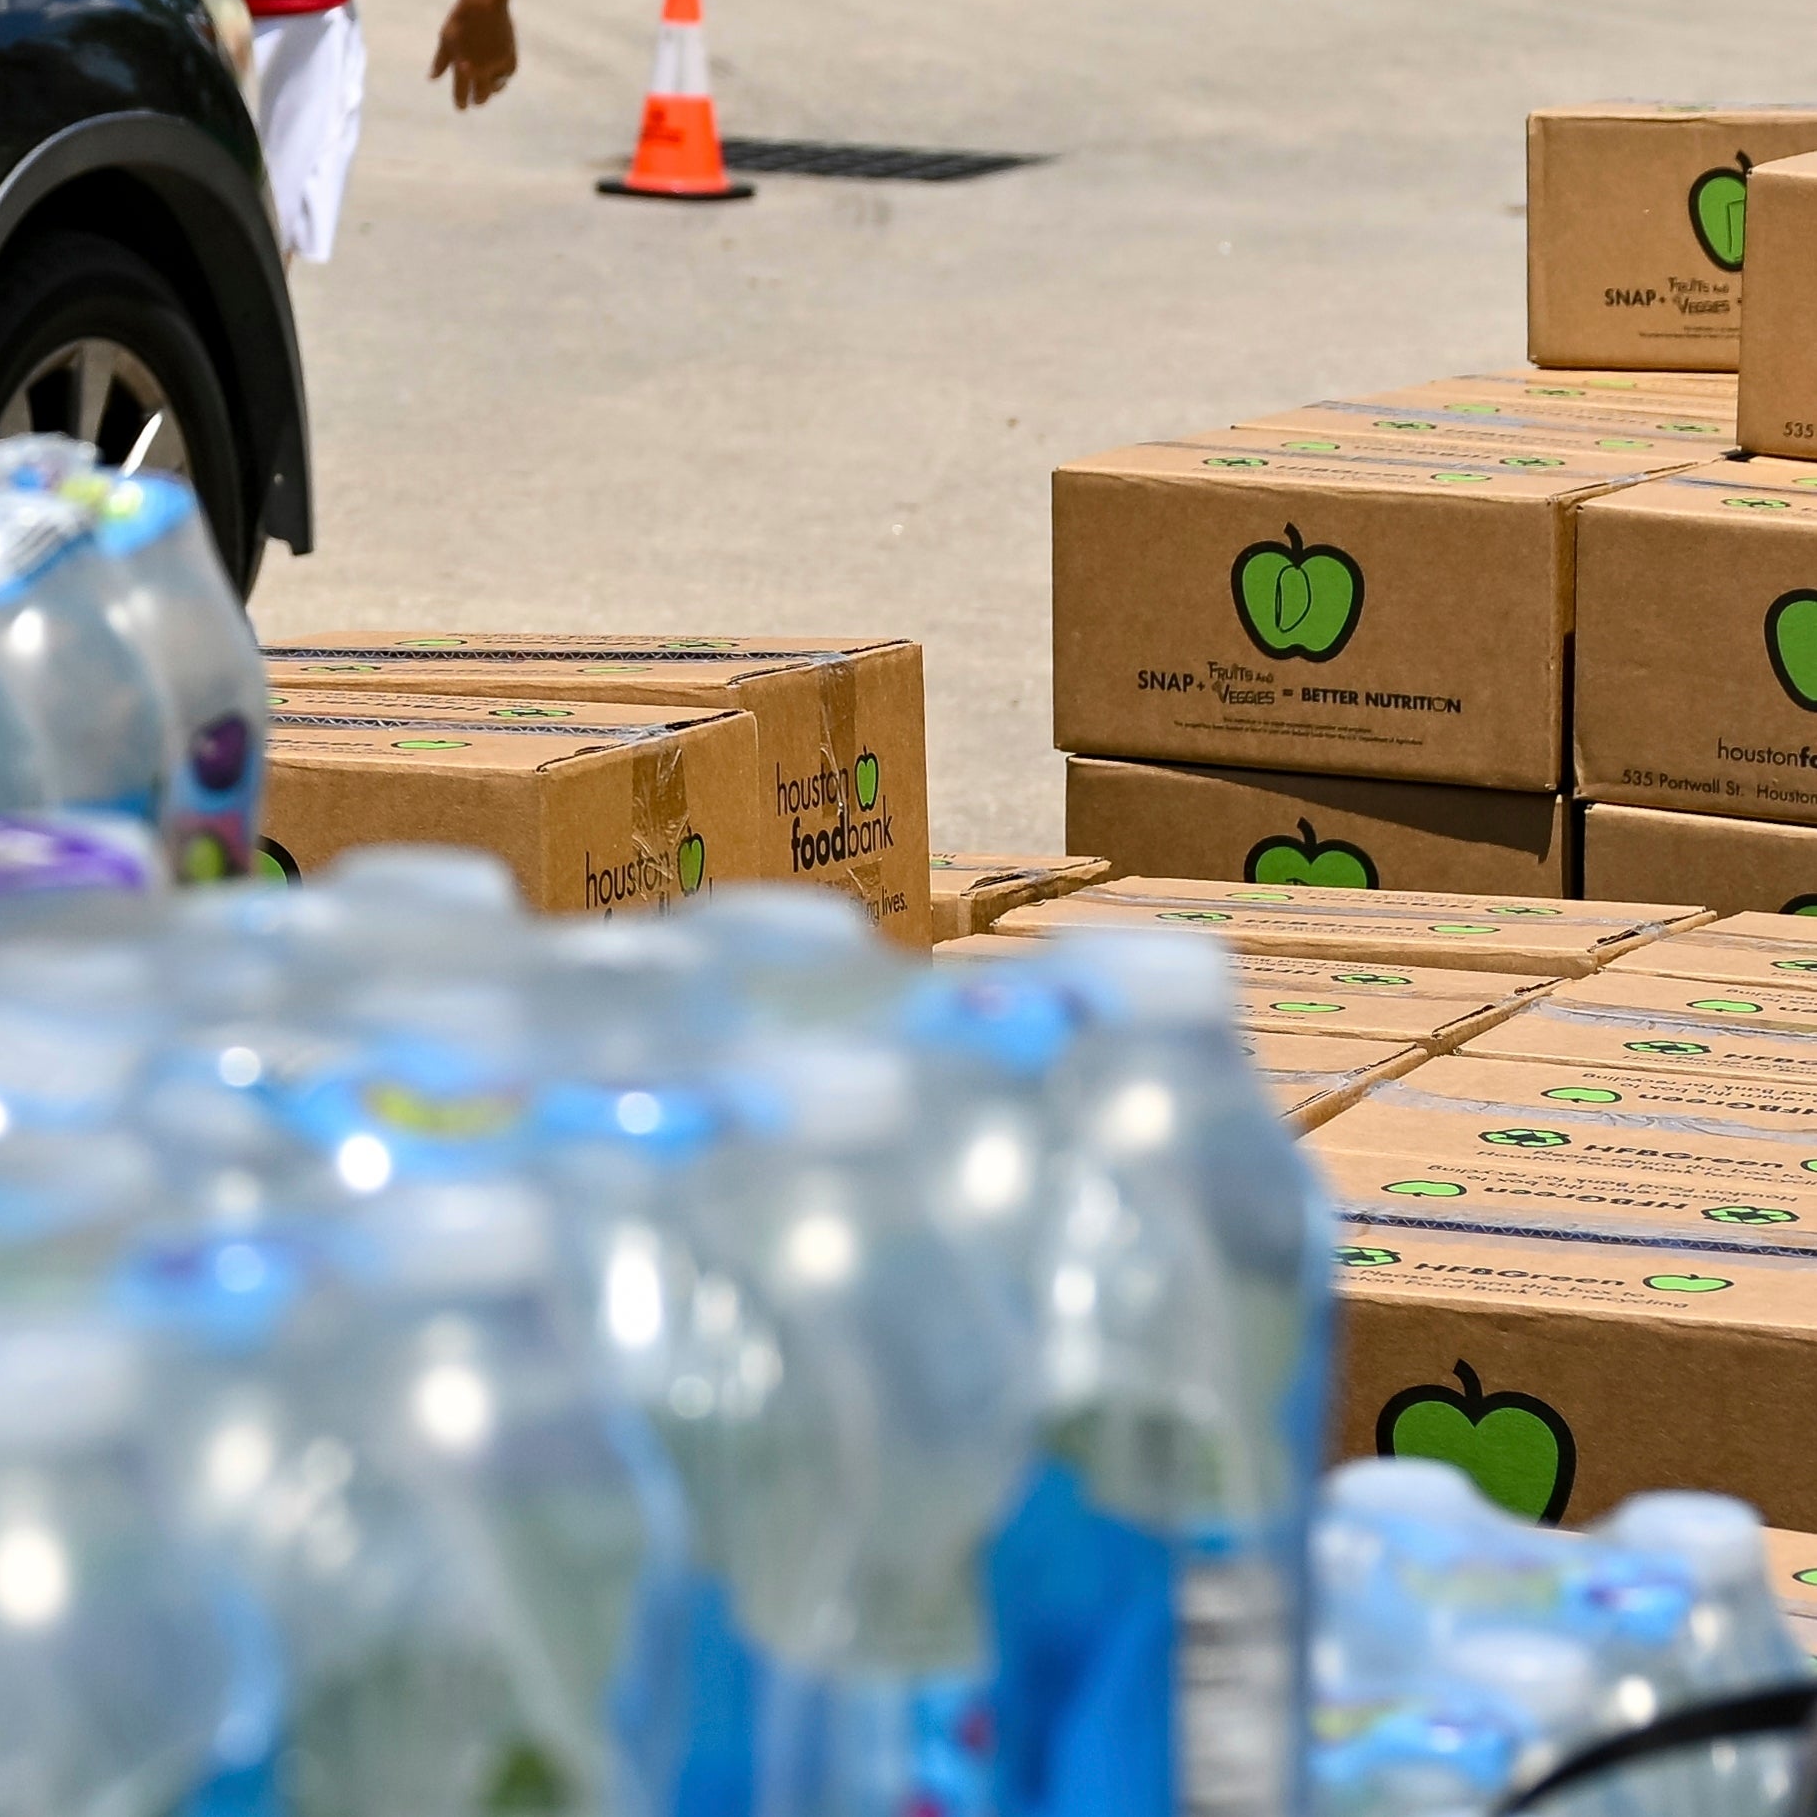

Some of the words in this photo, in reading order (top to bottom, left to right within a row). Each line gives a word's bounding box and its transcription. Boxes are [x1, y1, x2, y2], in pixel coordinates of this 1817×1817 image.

[1782, 421, 1814, 439] 535
[1301, 688, 1359, 706] BETTER
[1365, 691, 1462, 713] NUTRITION
[776, 762, 849, 816] houston
[1622, 769, 1653, 787] 535
[1659, 772, 1720, 794] Portwall
[1725, 780, 1745, 797] St.
[791, 795, 894, 873] foodbank
[585, 851, 671, 910] houston
[881, 886, 908, 916] lives.
[1583, 1144, 1784, 1169] HFBGreen
[1483, 1186, 1689, 1210] HFBGreen
[1360, 1270, 1433, 1281] Please
[1414, 1263, 1625, 1286] HFBGreen
[1473, 1286, 1527, 1295] Bank
[1582, 1294, 1689, 1309] recycling
